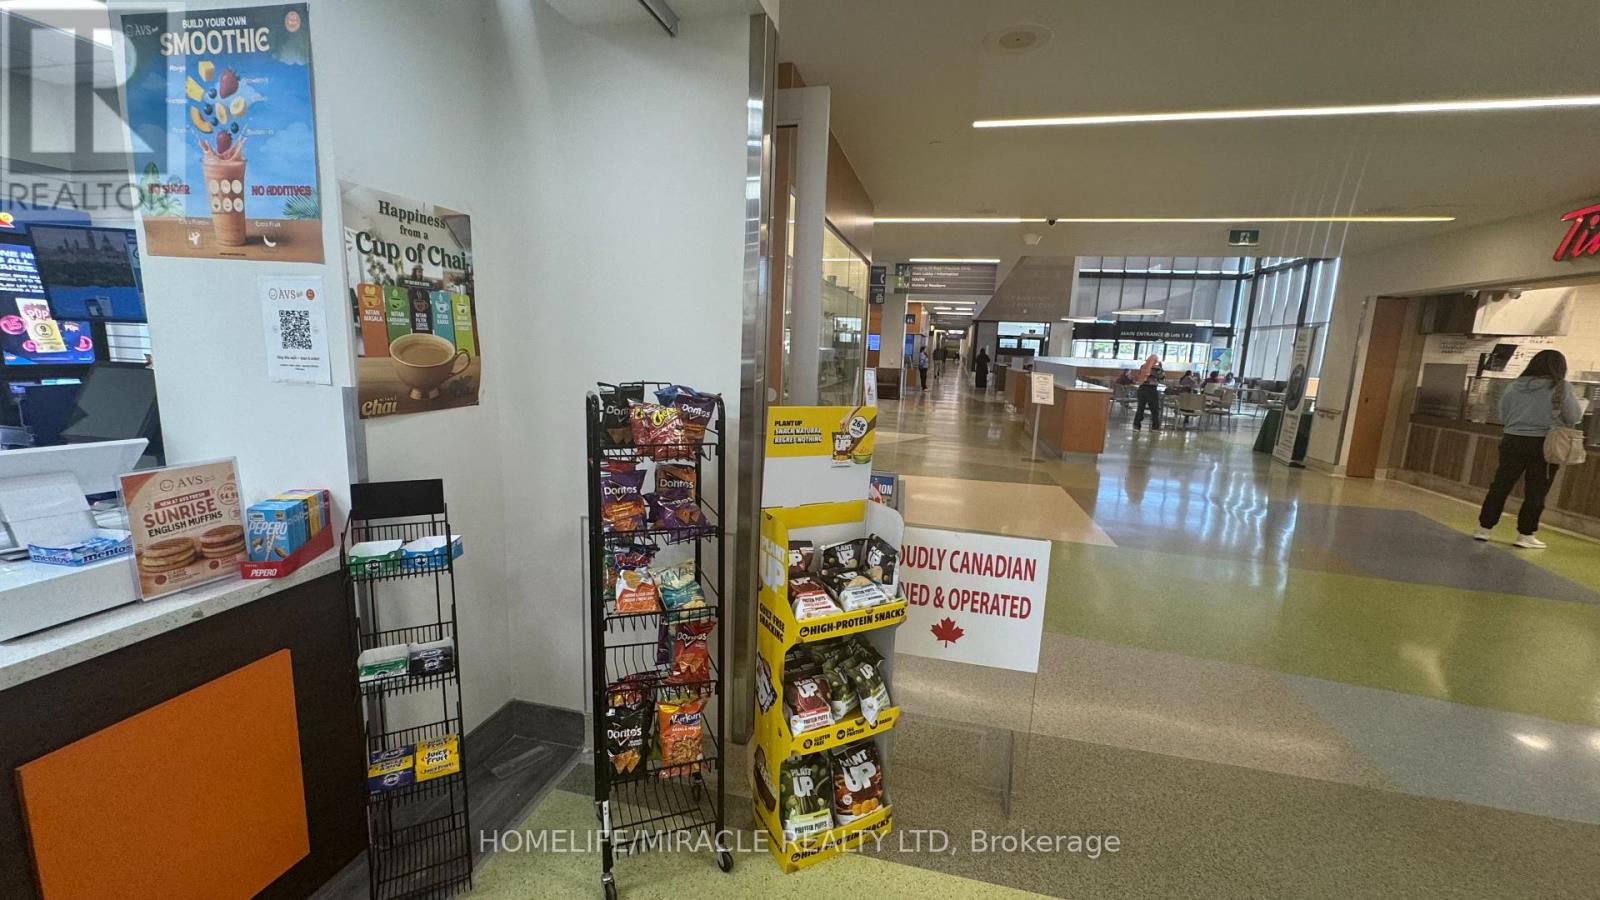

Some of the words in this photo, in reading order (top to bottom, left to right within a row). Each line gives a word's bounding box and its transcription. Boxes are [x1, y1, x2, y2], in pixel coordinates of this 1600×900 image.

[182, 18, 204, 29] BUILD
[205, 17, 227, 28] YOUR
[228, 15, 247, 26] OWN
[159, 28, 270, 56] SMOOTHIE
[251, 184, 265, 196] NO
[266, 185, 312, 197] ADDITIVES
[378, 200, 446, 229] Happiness
[400, 225, 423, 239] from
[423, 232, 429, 240] a
[356, 231, 400, 264] Cup
[405, 243, 425, 265] of
[279, 289, 296, 300] AVS
[681, 403, 711, 418] Doritos
[834, 439, 852, 451] UP
[177, 475, 203, 488] AVS
[659, 478, 694, 489] Doritos
[604, 486, 637, 496] Doritos
[143, 498, 218, 529] SUNRISE
[148, 519, 187, 538] ENGLISH
[187, 511, 223, 528] MUFFINS
[248, 521, 288, 535] PEPERO
[250, 568, 278, 577] PEPERO
[949, 550, 1037, 582] CANADIAN
[933, 585, 945, 609] &
[948, 588, 1032, 620] OPERATED
[759, 612, 785, 644] SNACKING
[773, 614, 785, 632] FREE
[810, 614, 873, 636] HIGH-PROTEIN
[874, 607, 905, 622] SNACKS
[607, 726, 642, 740] Doritos
[842, 761, 877, 792] UP
[793, 775, 814, 797] UP
